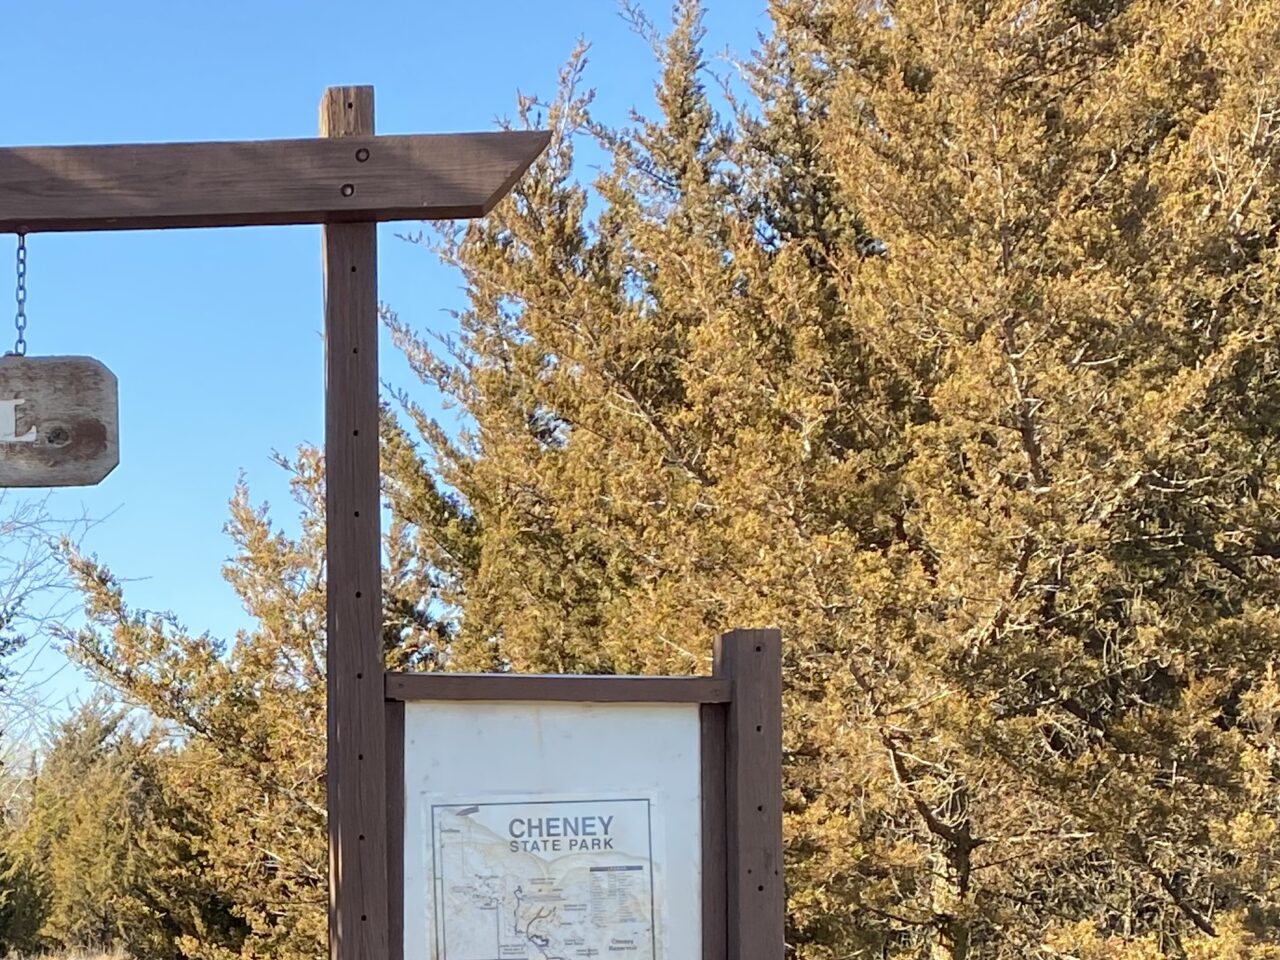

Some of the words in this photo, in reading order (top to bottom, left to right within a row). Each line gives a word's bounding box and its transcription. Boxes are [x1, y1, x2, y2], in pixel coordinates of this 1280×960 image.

[508, 815, 614, 838] CHENEY
[510, 839, 561, 852] STATE
[568, 838, 614, 850] PARK
